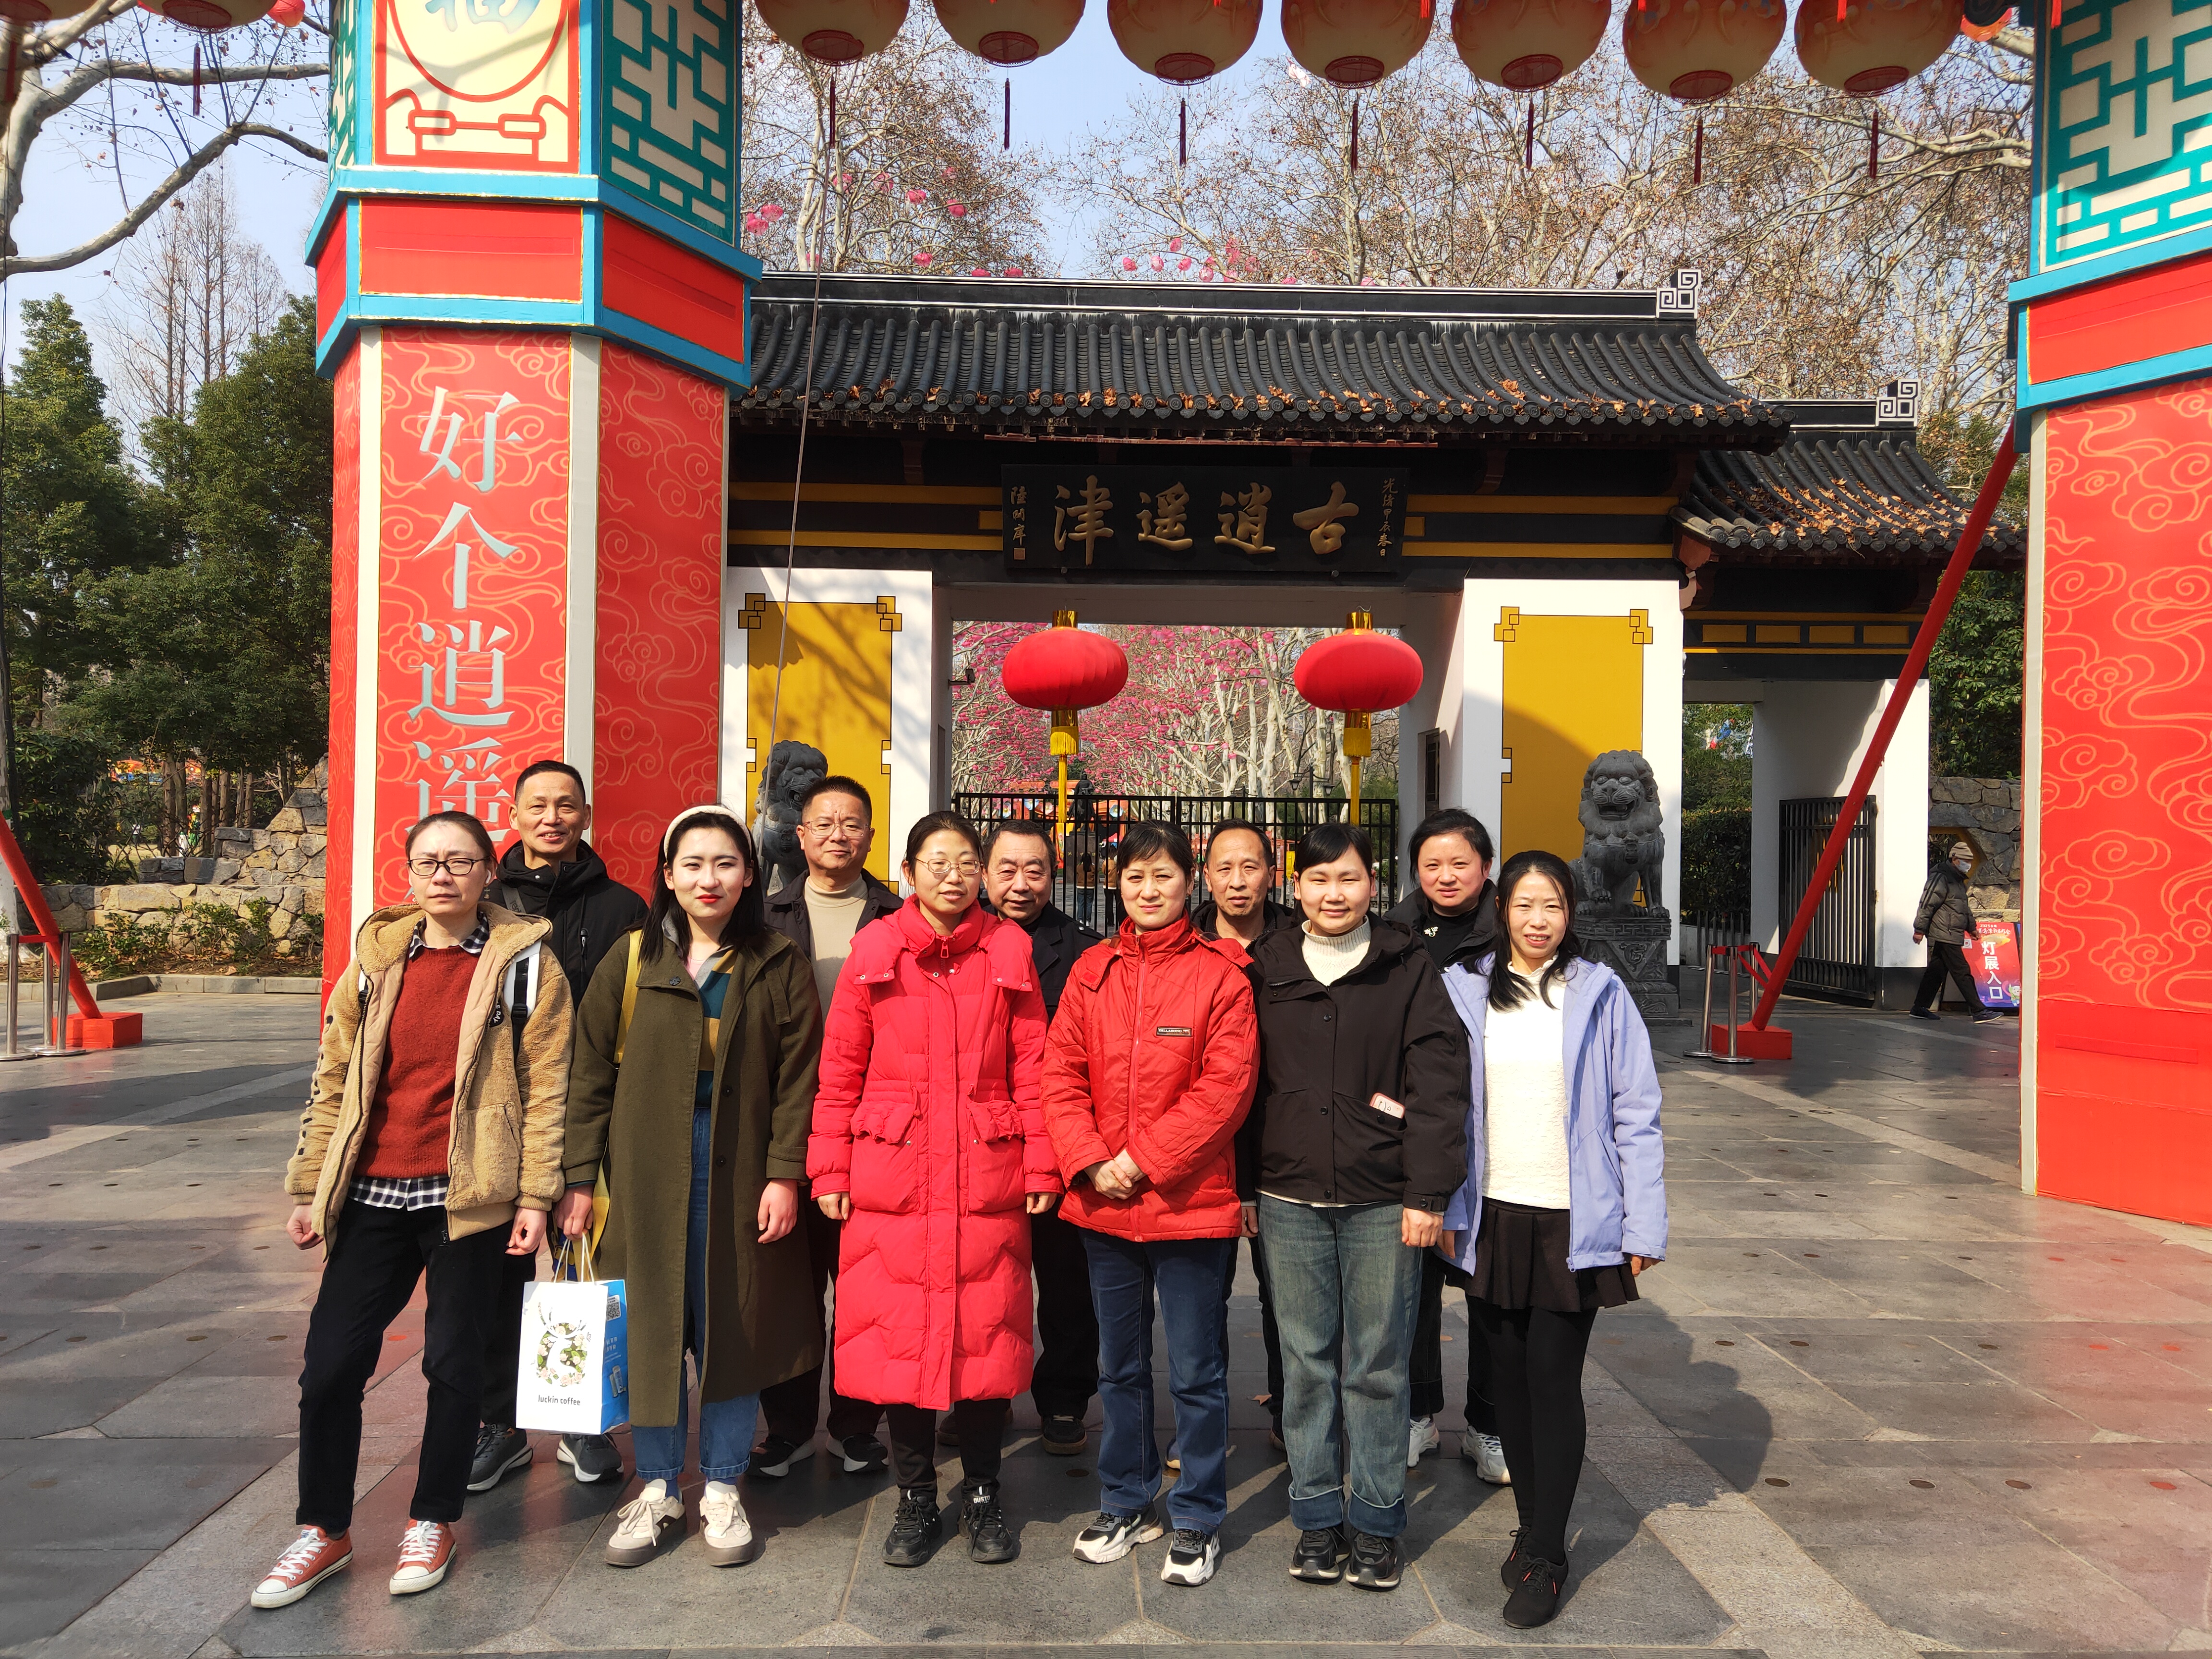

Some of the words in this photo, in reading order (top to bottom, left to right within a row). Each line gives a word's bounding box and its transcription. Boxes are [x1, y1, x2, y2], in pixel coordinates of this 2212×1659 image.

[405, 385, 524, 888] 好个逍遥
[1981, 941, 2003, 999] 灯展入口
[493, 1010, 501, 1023] DAY
[538, 1395, 558, 1403] luckin
[560, 1397, 581, 1406] coffee
